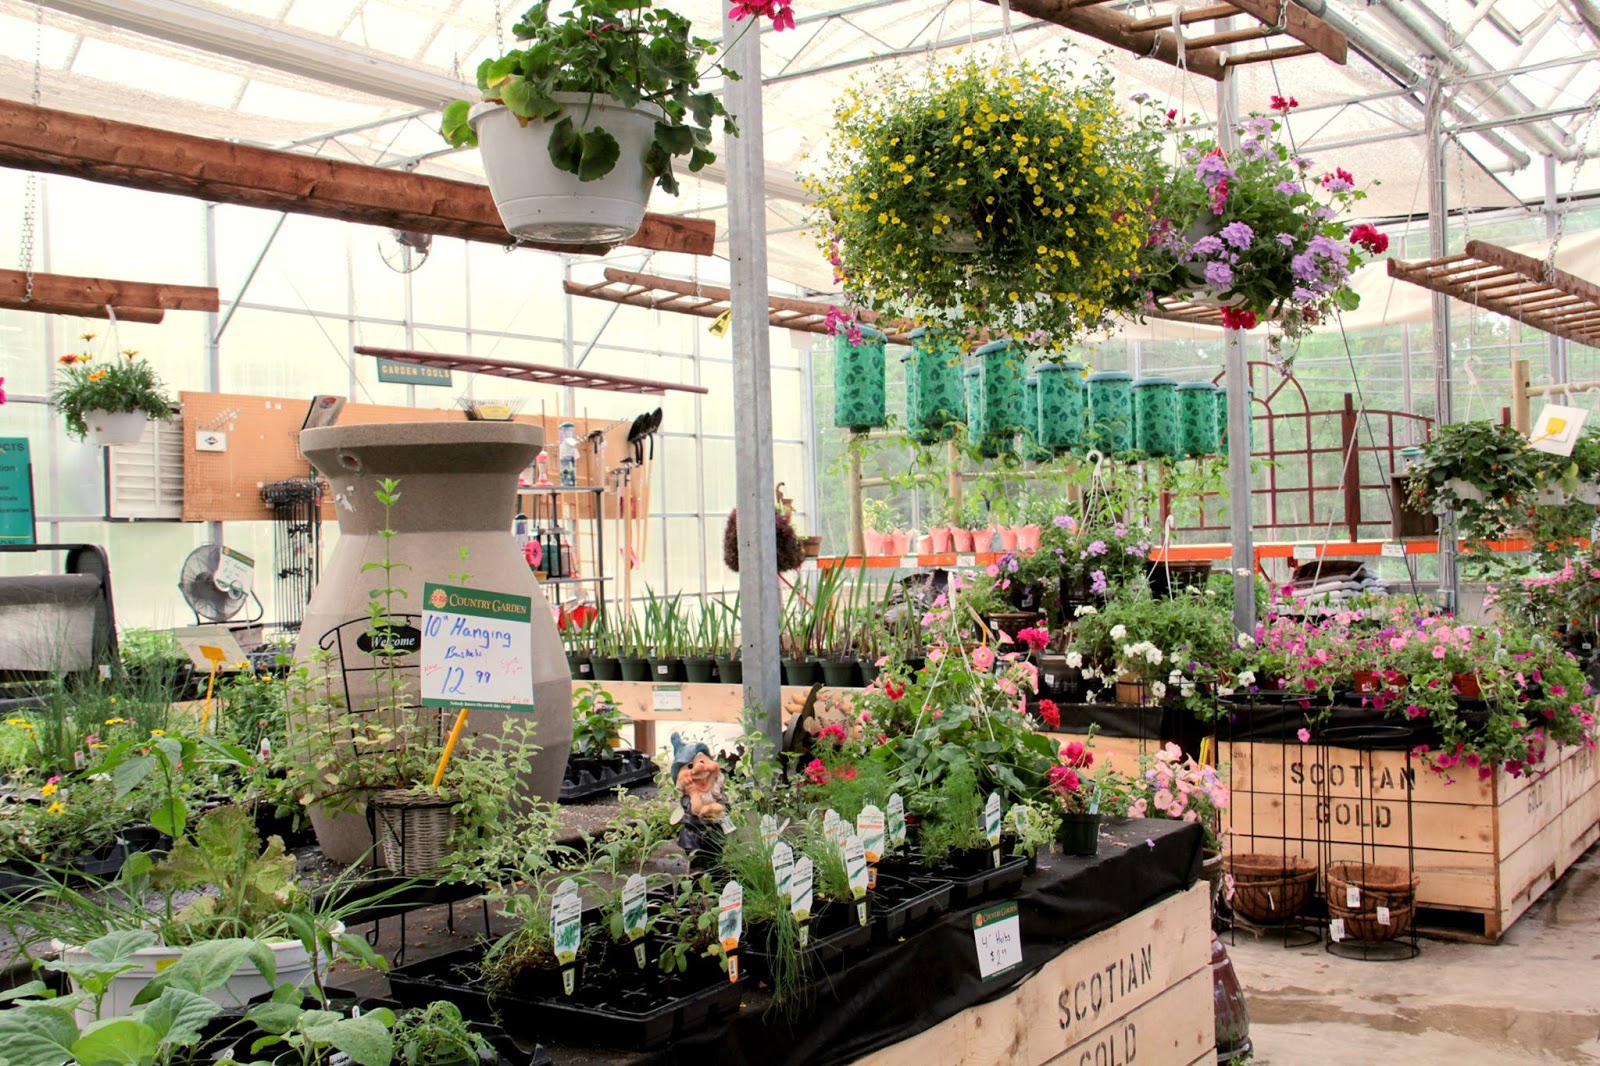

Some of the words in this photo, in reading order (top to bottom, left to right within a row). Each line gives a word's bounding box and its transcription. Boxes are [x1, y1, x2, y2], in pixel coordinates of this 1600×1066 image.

[381, 365, 418, 376] GARDEN
[420, 367, 450, 378] TOOLS
[0, 442, 24, 452] CTS
[449, 593, 491, 610] COUNTRY
[492, 600, 527, 614] GARDEN
[450, 617, 512, 649] Hanging
[1316, 802, 1392, 829] GOLD
[1058, 943, 1152, 1030] SCOTIAN
